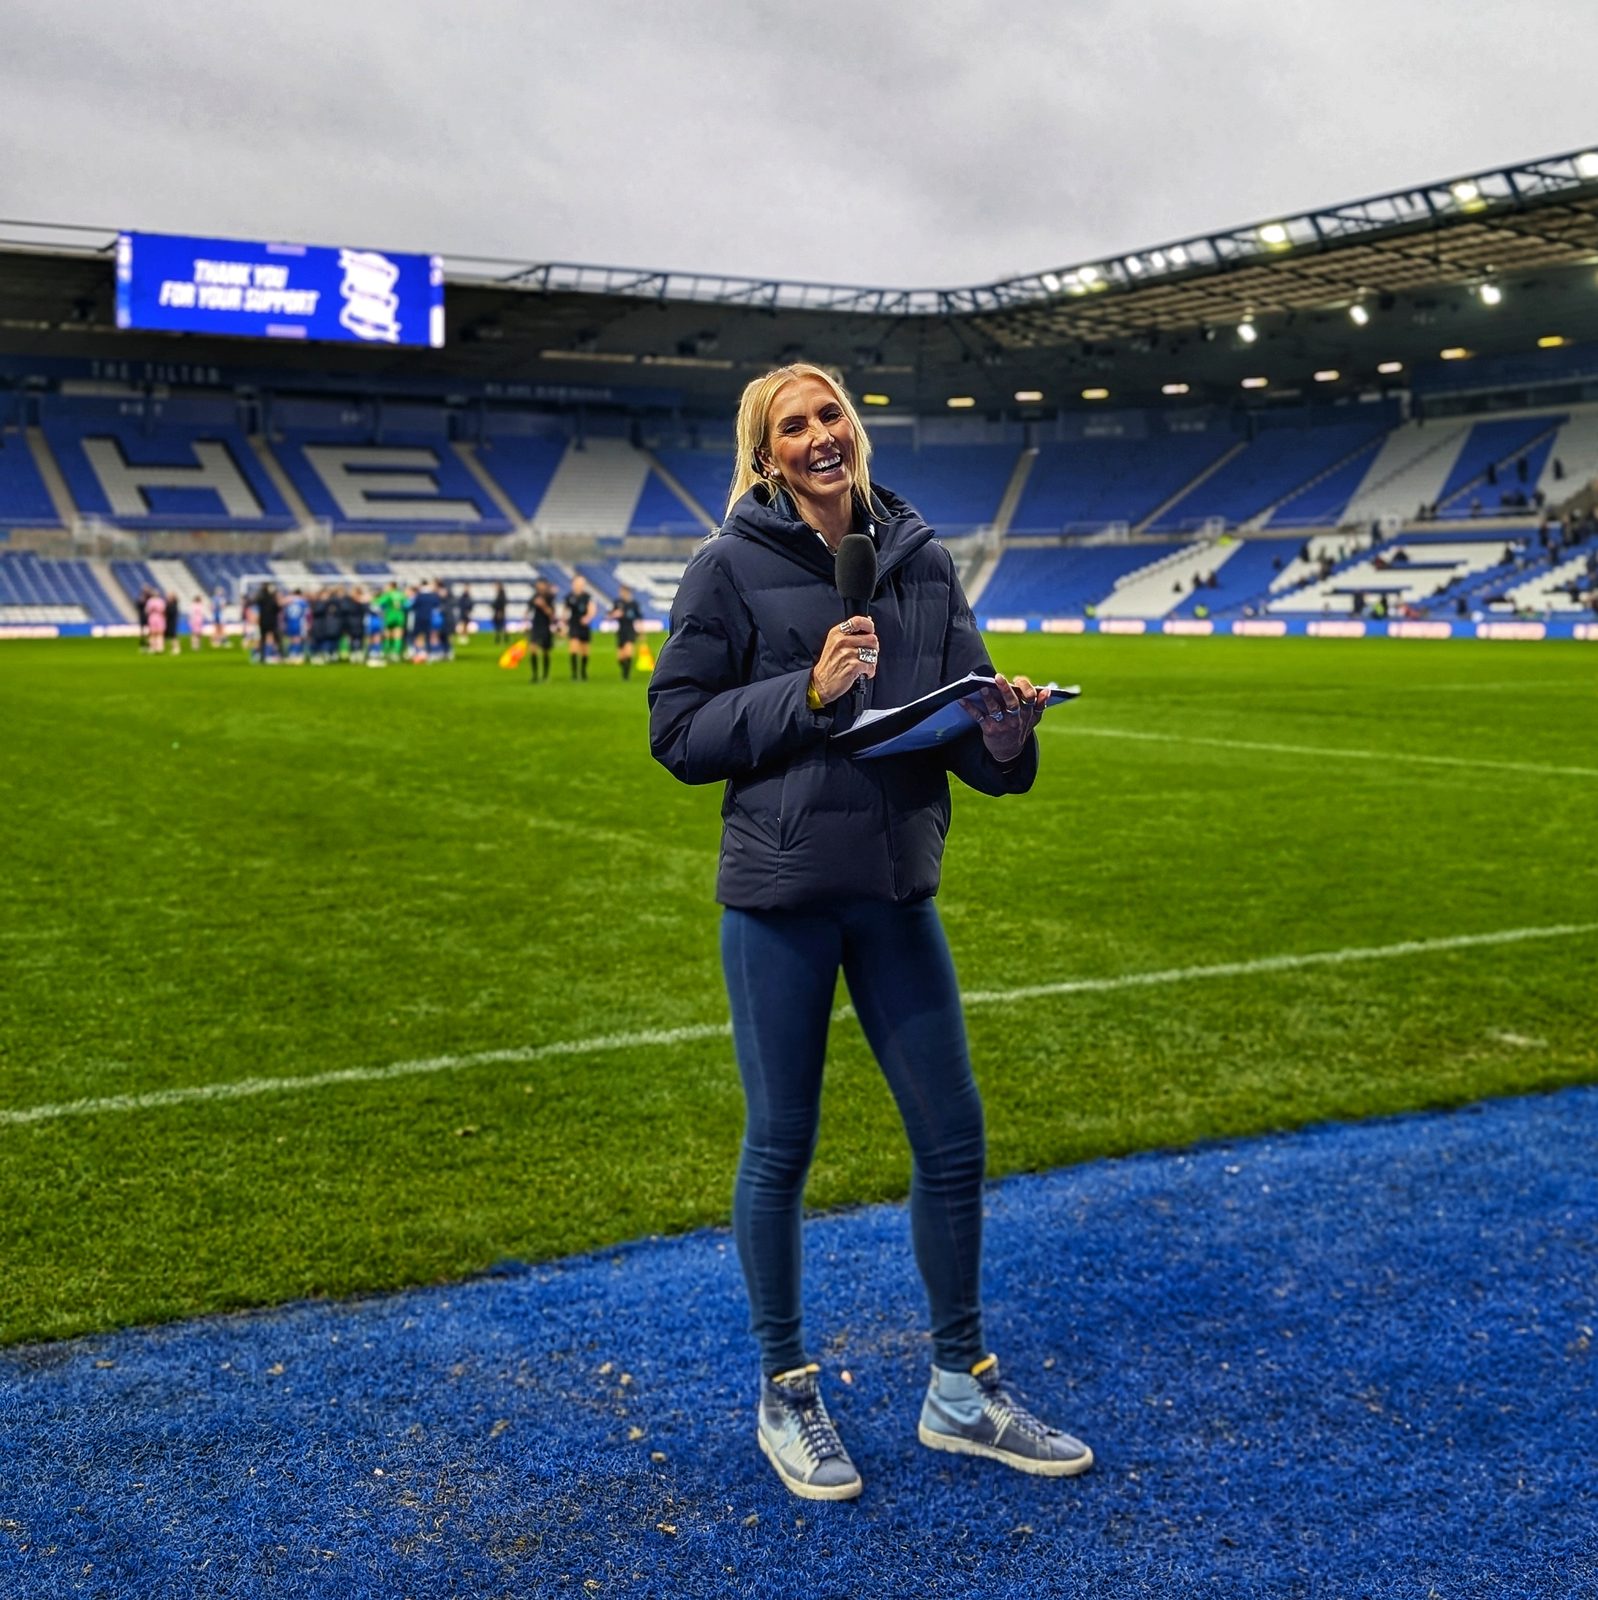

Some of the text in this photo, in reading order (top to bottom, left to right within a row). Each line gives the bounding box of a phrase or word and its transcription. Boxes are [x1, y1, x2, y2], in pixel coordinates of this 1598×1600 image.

[194, 259, 289, 288] THANK YOU
[159, 280, 320, 316] FOR YOUR SUPPORT
